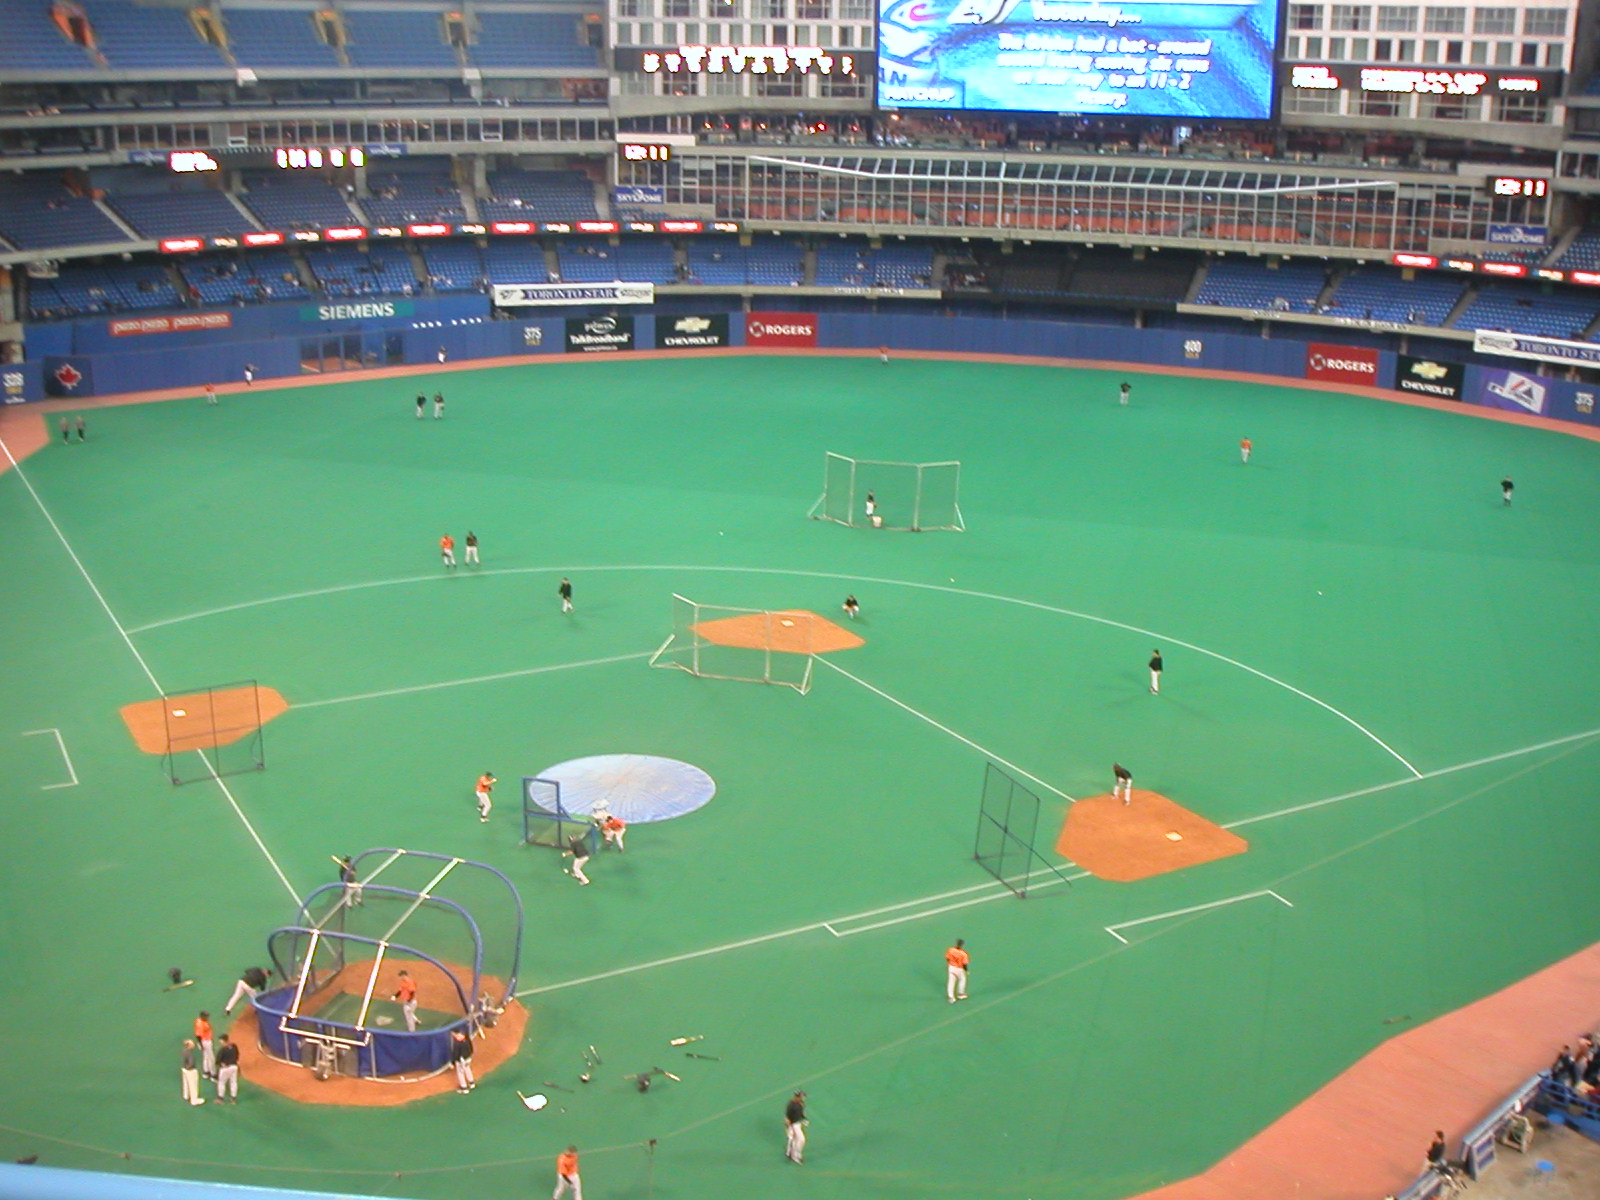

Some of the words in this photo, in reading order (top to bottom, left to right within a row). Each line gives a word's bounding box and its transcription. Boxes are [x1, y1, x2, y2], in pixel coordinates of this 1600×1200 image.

[527, 289, 582, 300] TORONTO
[584, 288, 614, 299] STAR
[319, 302, 395, 320] SIEMENS
[765, 324, 813, 336] ROGERS
[664, 336, 719, 346] CHEVROLET
[1520, 341, 1579, 358] TORONTO
[1326, 358, 1376, 374] ROGERS
[1401, 380, 1455, 396] CHEVROLET
